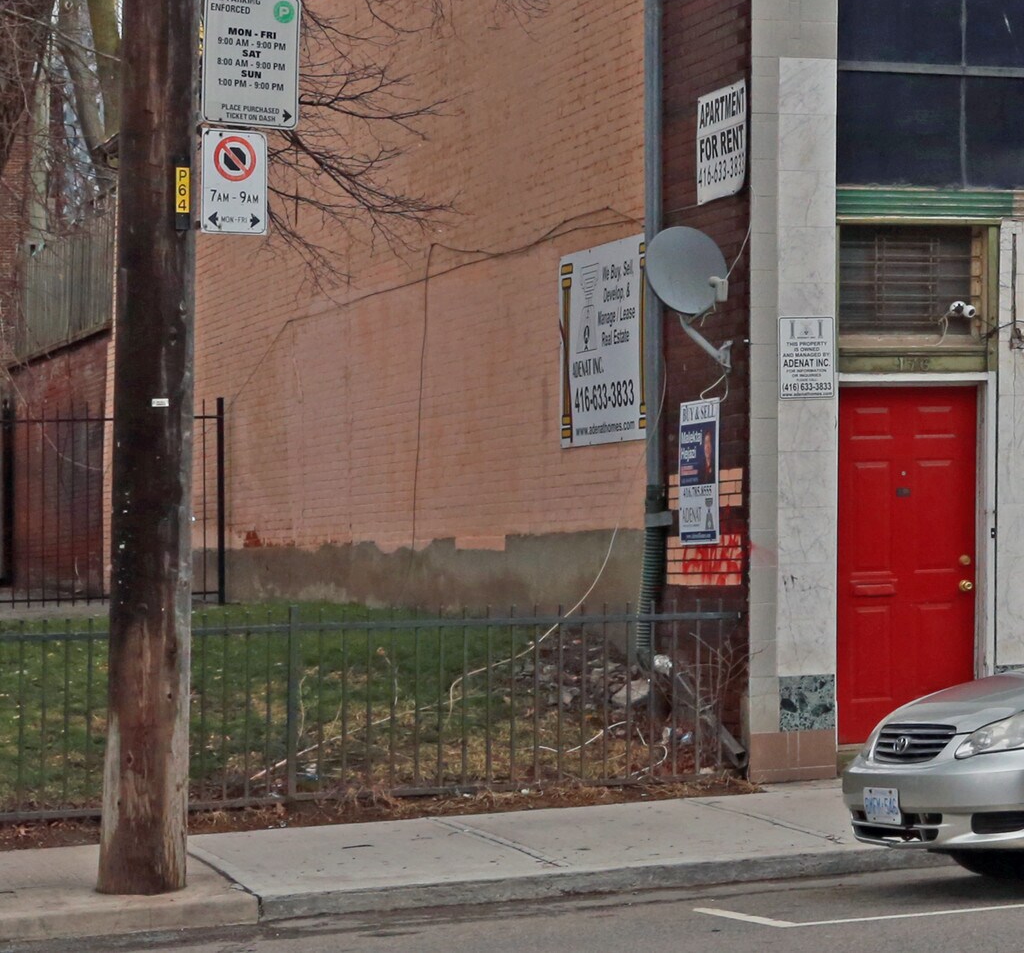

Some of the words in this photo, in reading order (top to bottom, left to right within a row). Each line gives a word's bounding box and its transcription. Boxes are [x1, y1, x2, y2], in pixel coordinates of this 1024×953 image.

[210, 2, 251, 15] ENFORCED
[228, 27, 252, 37] MON
[260, 30, 277, 39] FRI
[217, 36, 233, 45] 9:00
[235, 39, 249, 47] AM
[256, 41, 272, 50] 9:00
[273, 42, 286, 51] PM
[242, 49, 262, 58] SAT
[217, 57, 232, 66] 8:00
[235, 59, 248, 68] AM
[255, 61, 271, 70] 9:00
[273, 63, 286, 71] PM
[241, 69, 262, 79] SUN
[218, 78, 232, 87] 1:00
[234, 79, 247, 88] PM
[254, 81, 270, 90] 9:00
[271, 83, 284, 91] PM
[221, 103, 241, 112] PLACE
[243, 105, 280, 115] PURCHASED
[699, 87, 745, 129] APARTMENT
[226, 112, 247, 120] TICKET
[258, 114, 276, 122] DASH
[700, 134, 718, 163] FOR
[720, 124, 744, 157] RENT
[177, 168, 188, 211] P64
[210, 189, 230, 203] 7AM
[239, 191, 259, 204] 9AM
[221, 215, 248, 224] MON-FRI
[602, 265, 610, 282] We
[625, 281, 631, 298] &
[598, 310, 616, 328] Manage
[620, 305, 636, 322] Lease
[601, 329, 613, 347] Real
[613, 328, 630, 345] Estate
[783, 358, 814, 368] ADENAT
[816, 358, 831, 368] INC.
[782, 382, 800, 392] (416)
[800, 382, 832, 391] 633-3833
[574, 378, 635, 413] 416-633-3833
